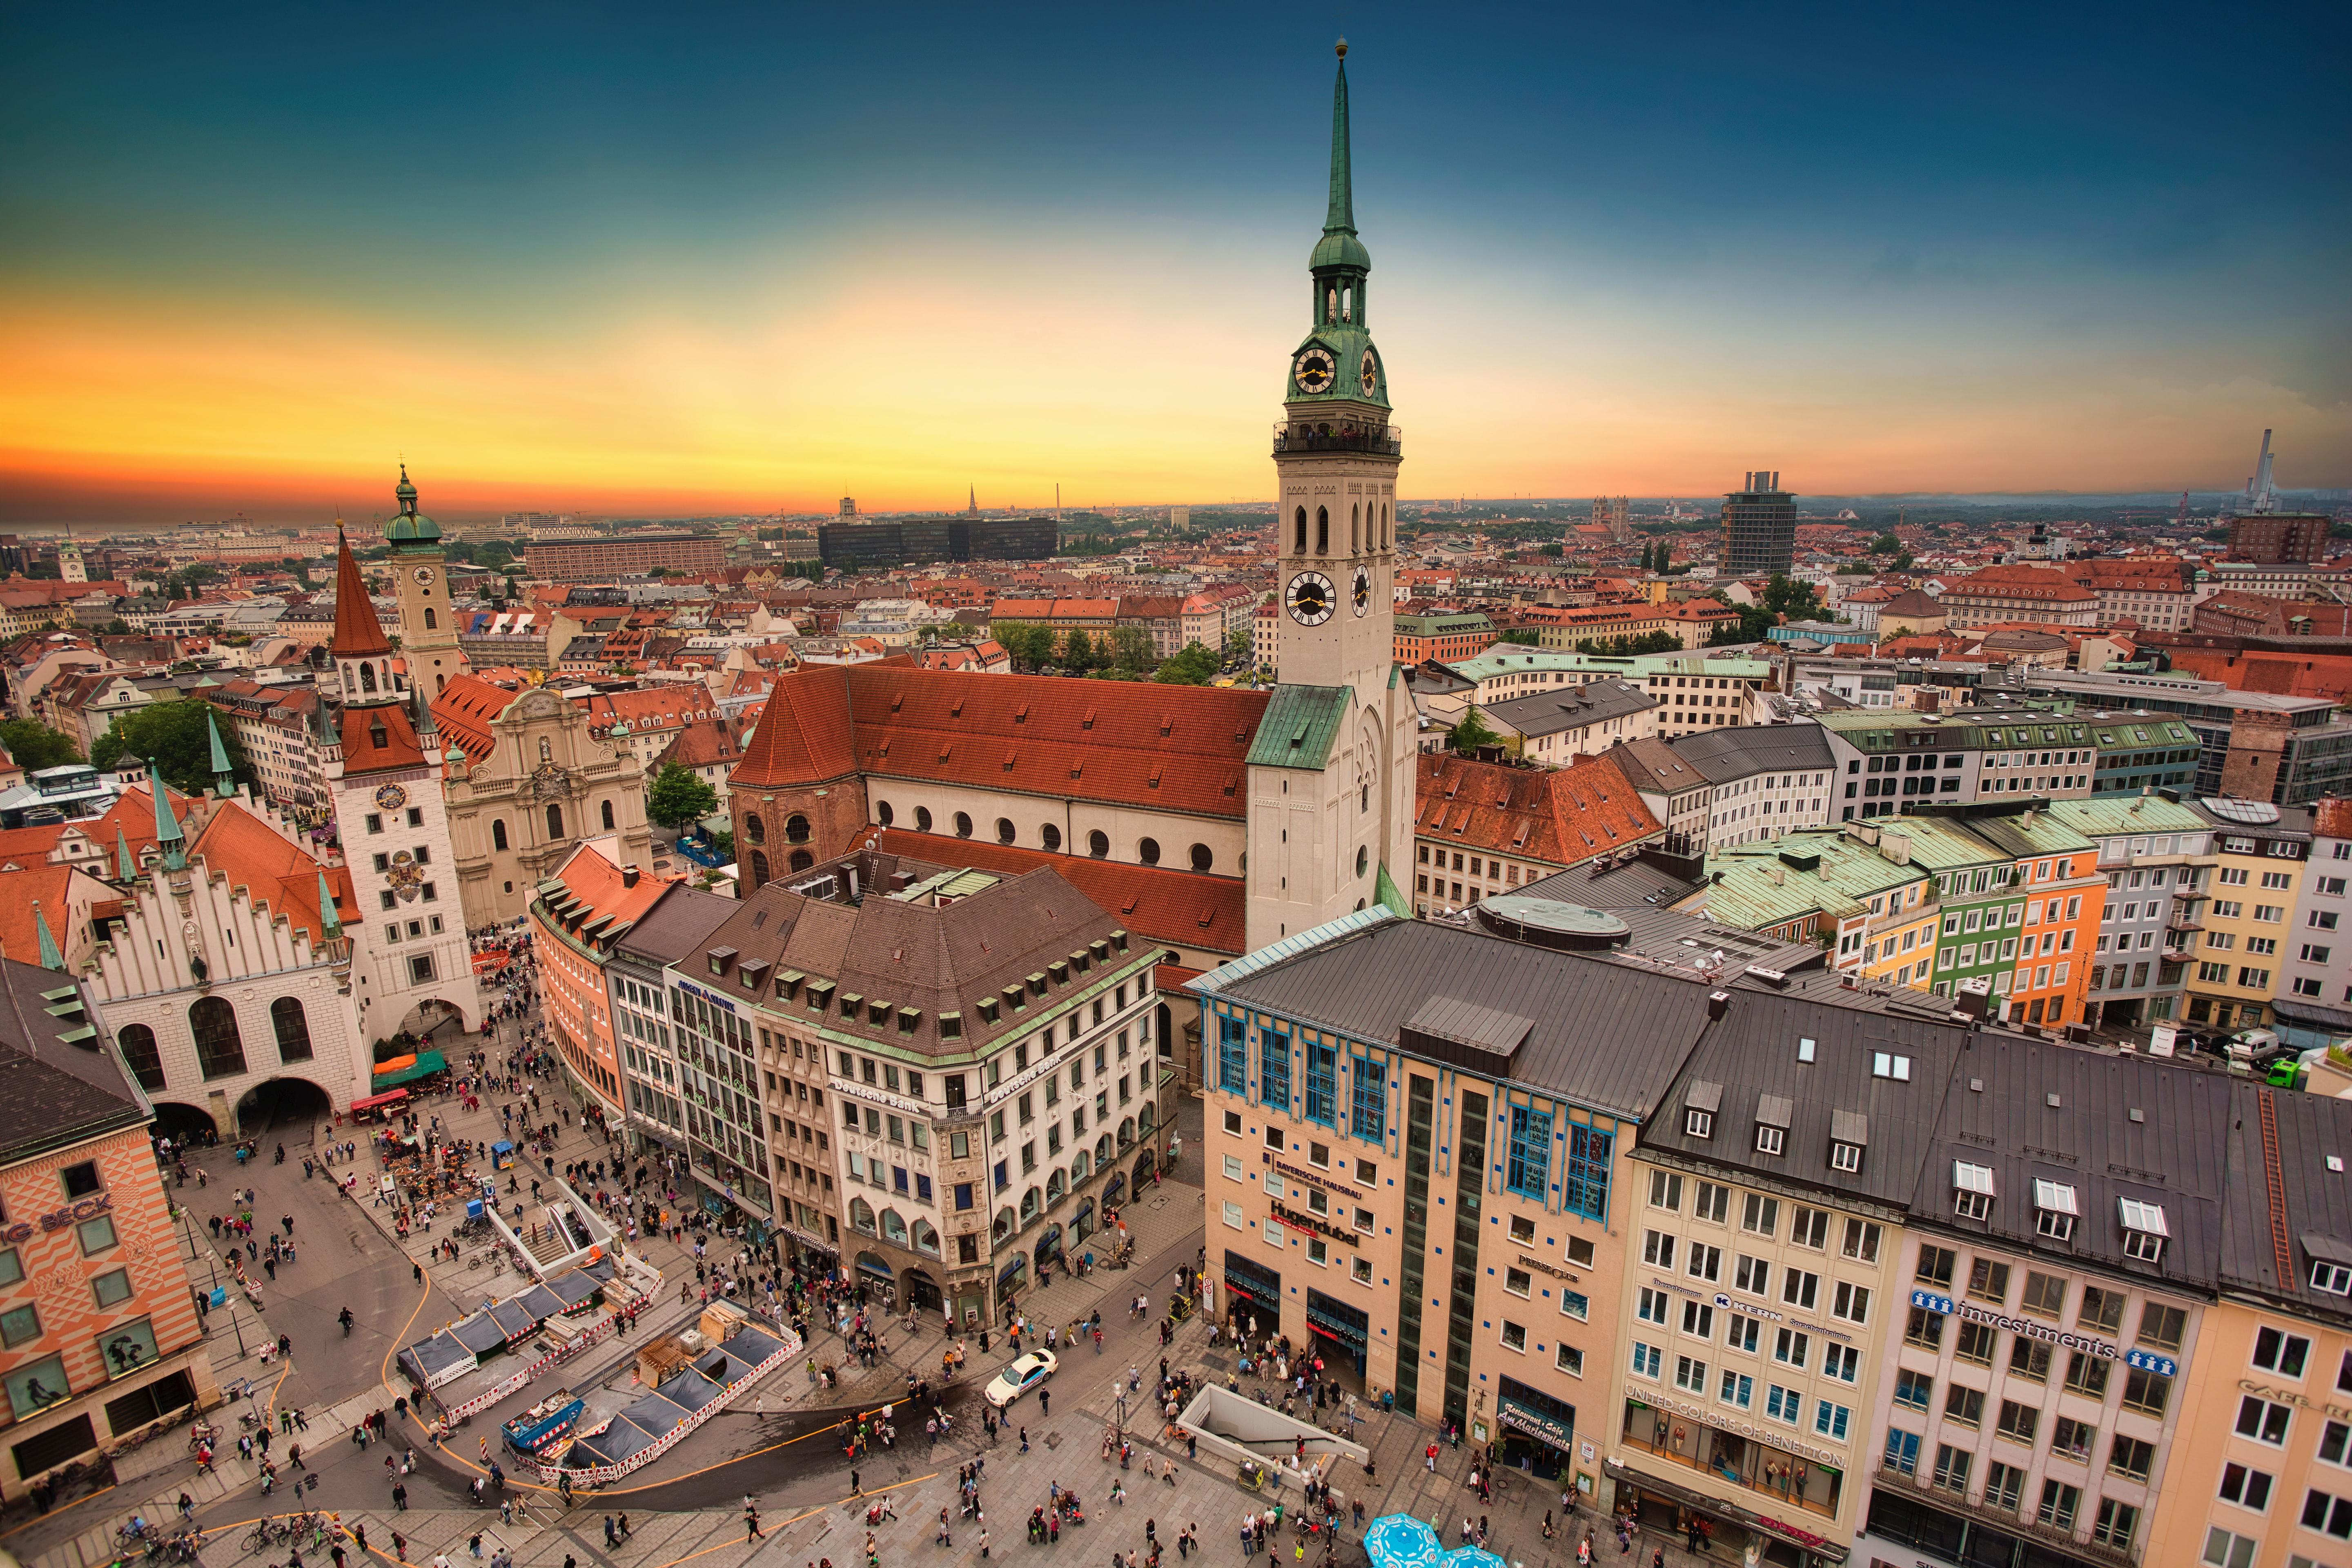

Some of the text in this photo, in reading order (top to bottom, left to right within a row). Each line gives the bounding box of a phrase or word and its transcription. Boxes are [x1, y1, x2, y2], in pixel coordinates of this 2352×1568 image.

[1290, 584, 1298, 592] X
[1297, 575, 1305, 586] XI
[1318, 577, 1324, 585] I
[1289, 606, 1298, 615] VIII
[1307, 616, 1313, 624] VI
[1318, 614, 1324, 623] V
[1323, 606, 1332, 615] IIII
[678, 980, 701, 997] AUGEN
[710, 994, 735, 1012] KLINIK
[990, 1054, 1063, 1104] Deutsche Bank
[834, 1079, 920, 1114] Deutsche Bank
[486, 1187, 494, 1195] U
[1276, 1160, 1362, 1200] BAYERISCHE HAUSBAU
[0, 1194, 114, 1246] IG BECK
[1271, 1200, 1359, 1248] Hugendubel
[1518, 1253, 1579, 1283] PRESSE CLUB
[1653, 1277, 1852, 1342] Übersetzungen K KERN Sprachentraining
[1958, 1300, 2120, 1362] investments.
[2238, 1379, 2309, 1407] CAFE
[1505, 1403, 1541, 1425] Restaurant
[1625, 1384, 1674, 1409] UNITED
[1678, 1403, 1736, 1430] COLORS
[1740, 1423, 1761, 1438] OF
[1497, 1411, 1516, 1424] Am
[1514, 1418, 1570, 1451] Marienplatz
[1720, 1503, 1731, 1511] 25
